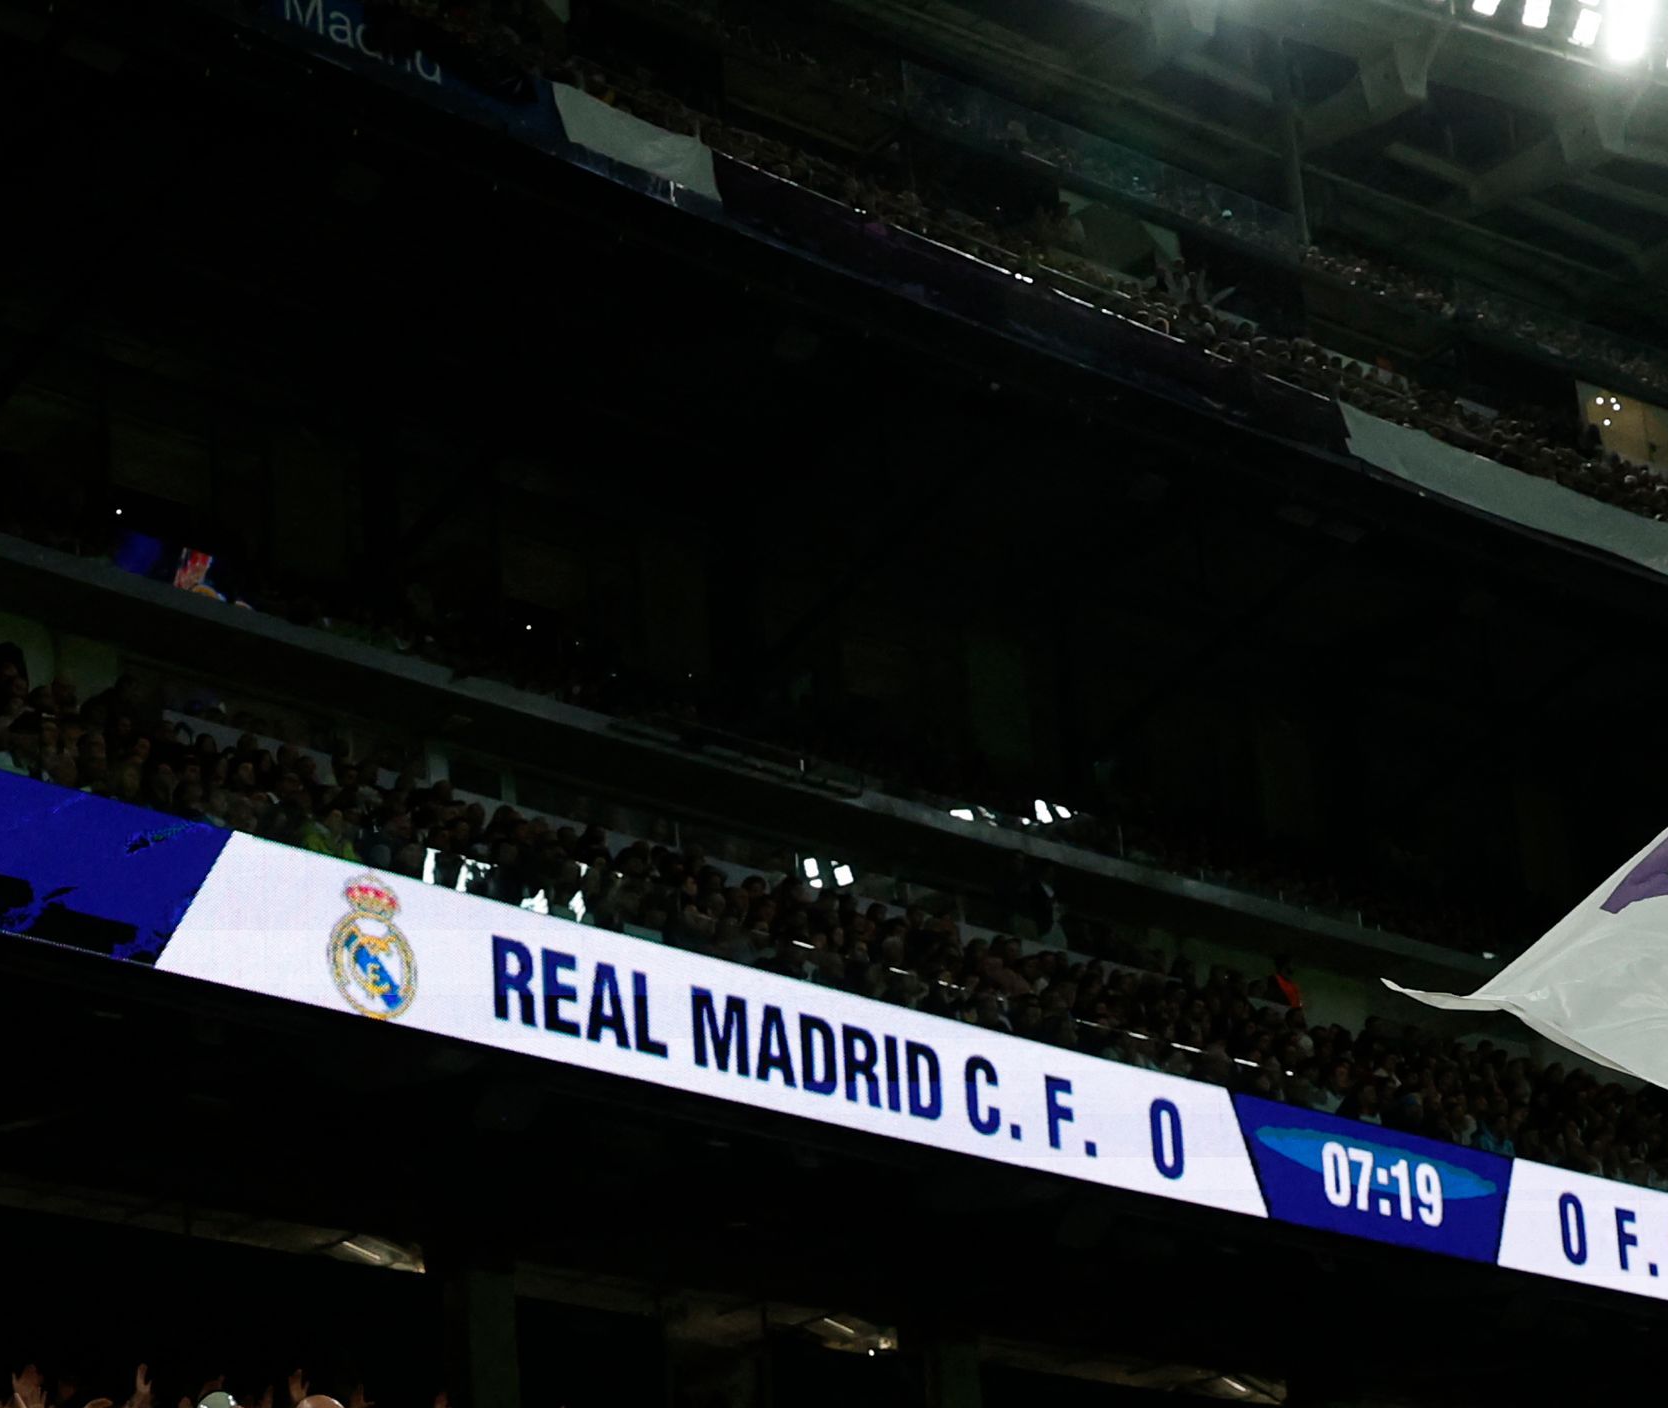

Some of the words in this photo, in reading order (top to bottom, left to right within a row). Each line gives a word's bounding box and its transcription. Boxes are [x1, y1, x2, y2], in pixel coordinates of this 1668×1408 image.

[491, 935, 668, 1058] REAL
[692, 987, 942, 1121] MADRID
[1149, 1098, 1184, 1179] 0
[1322, 1141, 1443, 1227] 07:19
[1559, 1193, 1587, 1266] 0
